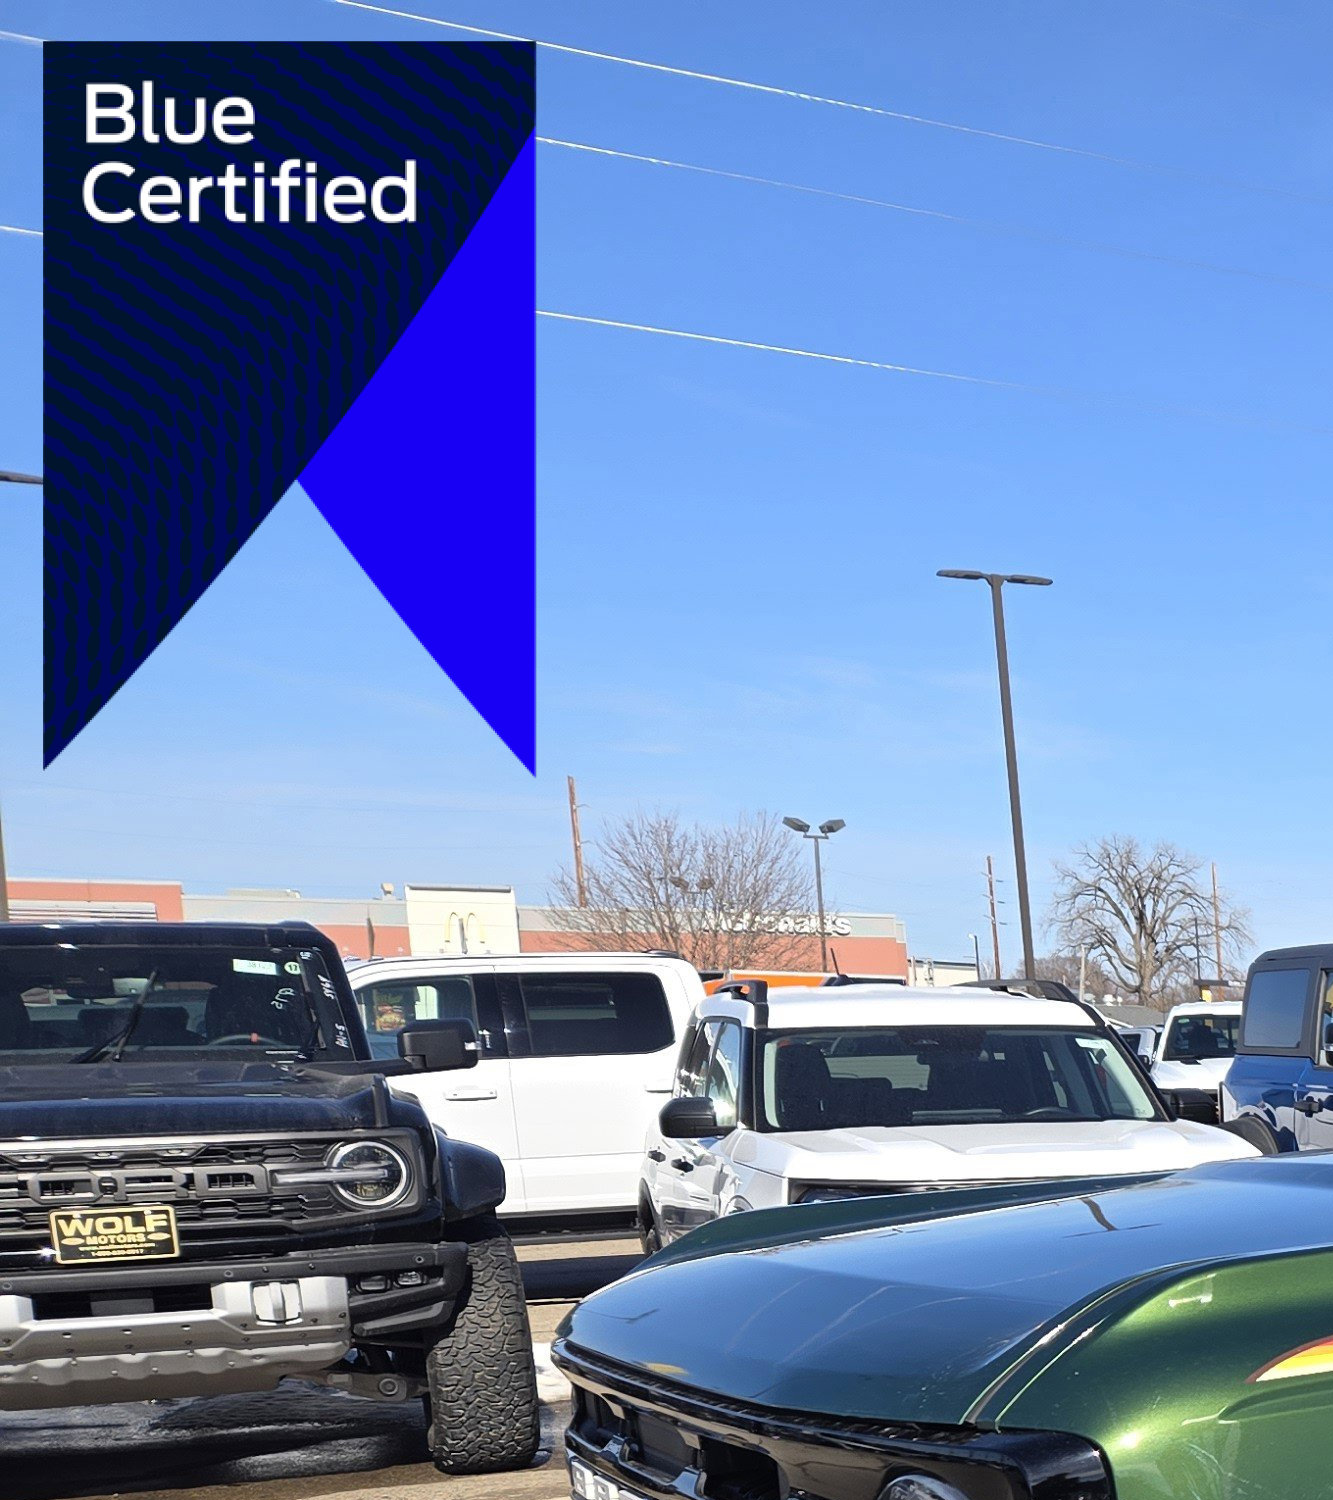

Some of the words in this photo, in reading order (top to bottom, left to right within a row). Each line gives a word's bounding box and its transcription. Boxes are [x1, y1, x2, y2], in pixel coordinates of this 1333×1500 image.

[0, 1164, 269, 1205] ORD
[57, 1213, 168, 1237] WOLF
[86, 1233, 146, 1245] MOTORS
